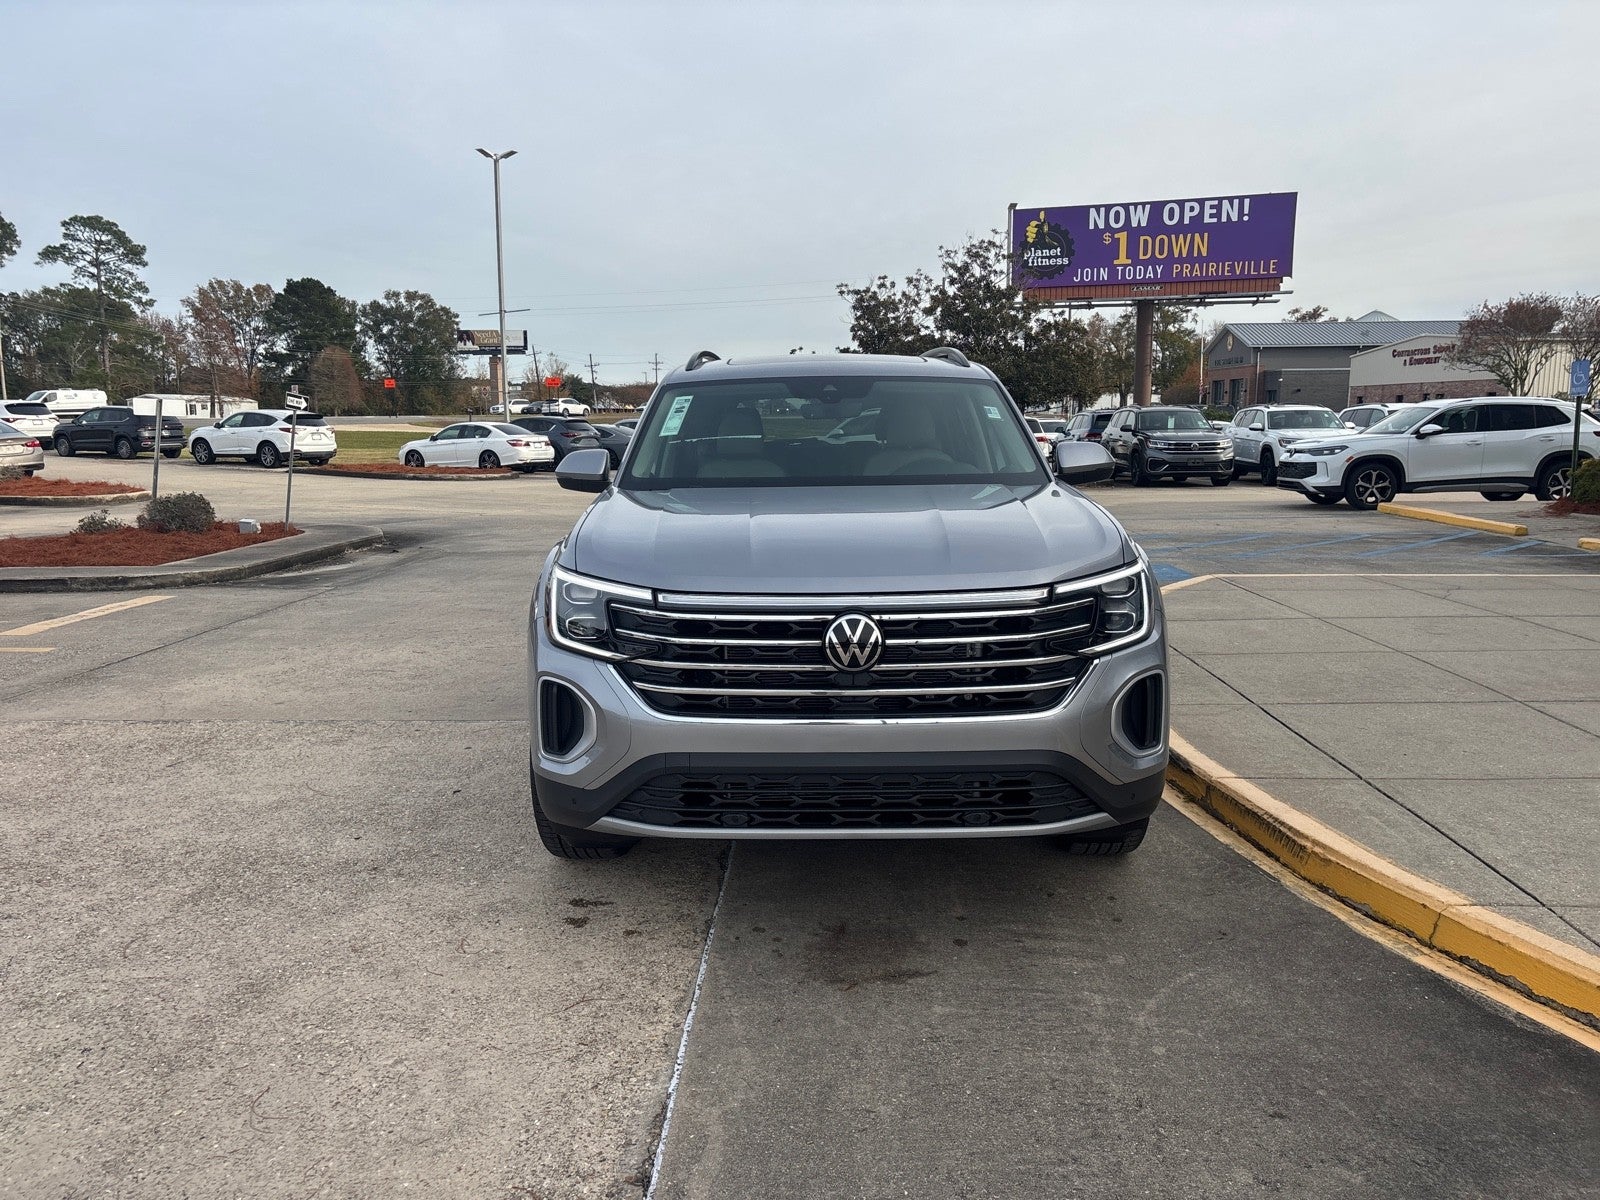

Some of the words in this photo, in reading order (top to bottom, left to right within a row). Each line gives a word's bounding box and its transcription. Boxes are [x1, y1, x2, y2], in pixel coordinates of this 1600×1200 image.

[1088, 204, 1151, 230] NOW
[1162, 197, 1251, 226] OPEN!
[1023, 246, 1062, 260] planet
[1139, 232, 1209, 260] DOWN
[1027, 256, 1069, 267] fitness
[1073, 266, 1109, 282] JOIN
[1116, 264, 1164, 281] TODAY
[1172, 259, 1278, 278] PRAIRIEVILLE
